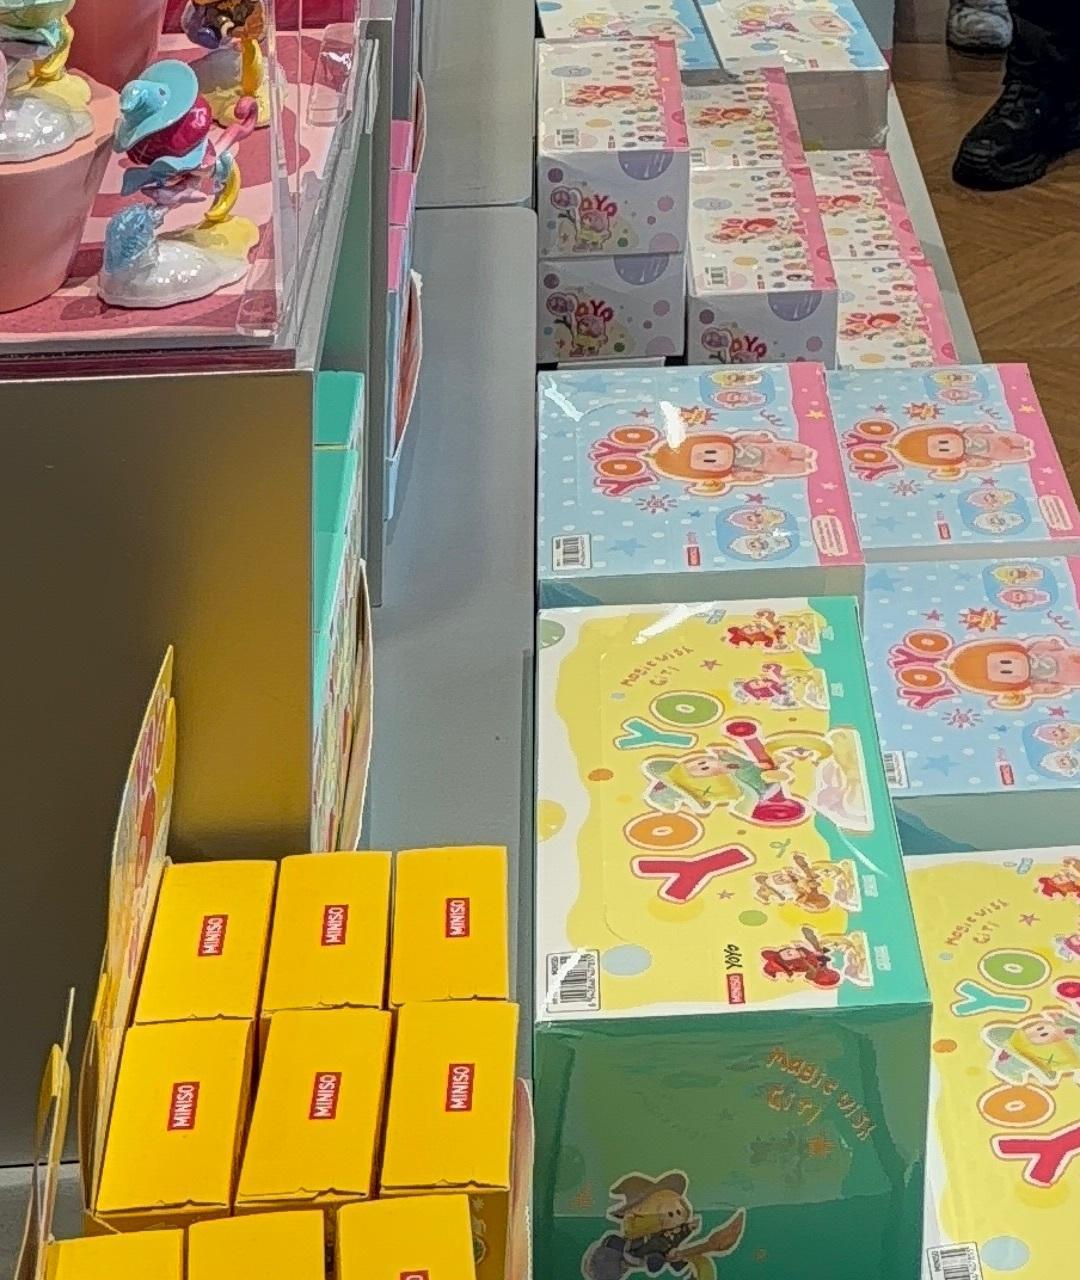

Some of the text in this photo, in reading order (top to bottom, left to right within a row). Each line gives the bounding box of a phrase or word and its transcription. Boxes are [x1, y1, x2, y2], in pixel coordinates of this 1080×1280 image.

[588, 425, 662, 497] YOYO
[841, 418, 903, 481] YOYO
[888, 629, 960, 710] YOYO
[202, 917, 224, 955] MINISO
[325, 906, 345, 944] MINISO
[449, 899, 466, 937] MINISO
[724, 944, 743, 970] YOYO
[172, 1084, 196, 1128] MINISO
[313, 1074, 336, 1118] MINISO
[450, 1065, 470, 1109] MINISO
